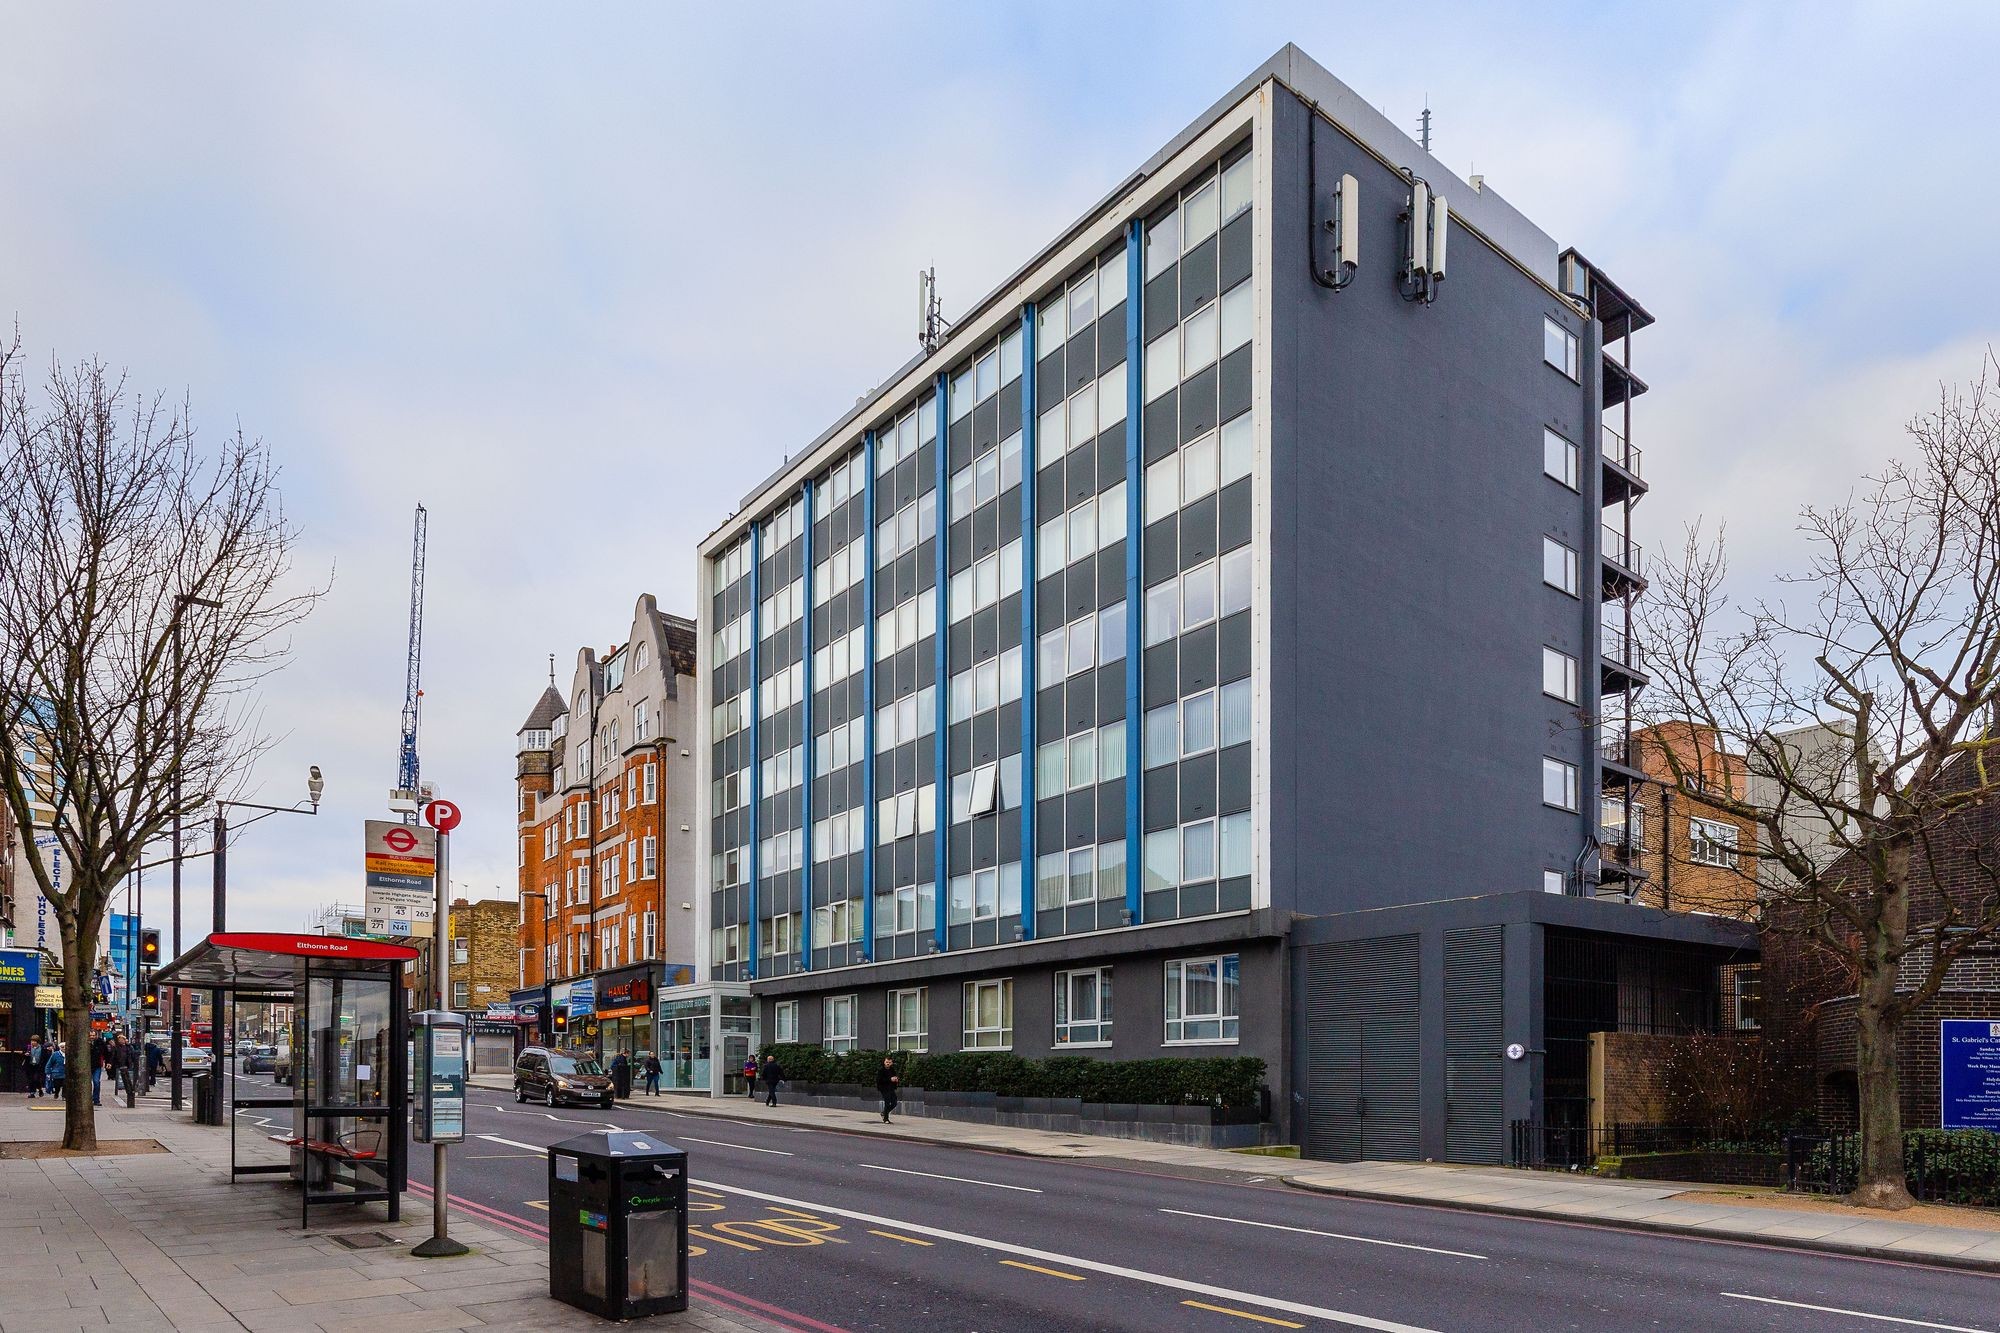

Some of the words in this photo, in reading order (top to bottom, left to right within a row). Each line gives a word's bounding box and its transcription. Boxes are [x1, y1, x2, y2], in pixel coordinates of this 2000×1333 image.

[435, 804, 453, 825] P
[379, 876, 406, 884] Elthorne
[391, 891, 411, 899] Highgate
[415, 910, 430, 918] 263
[371, 922, 384, 930] 271
[297, 942, 328, 950] Elthorne
